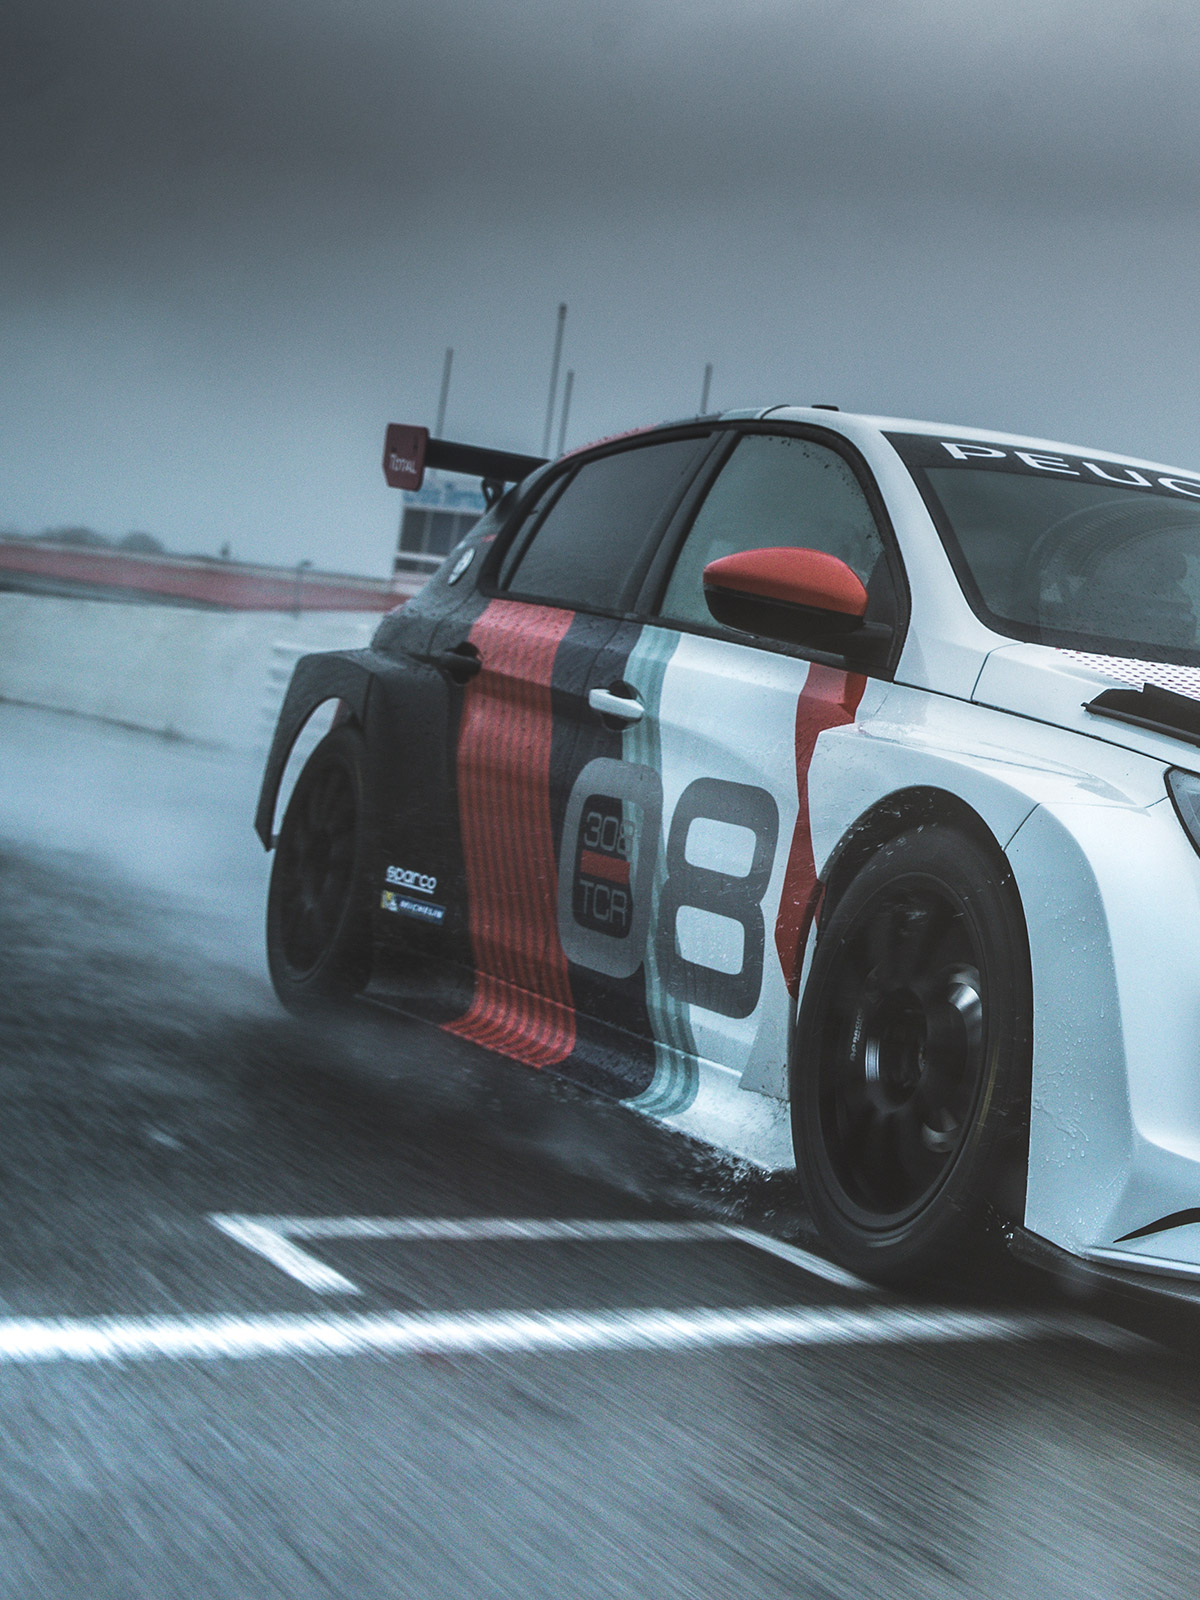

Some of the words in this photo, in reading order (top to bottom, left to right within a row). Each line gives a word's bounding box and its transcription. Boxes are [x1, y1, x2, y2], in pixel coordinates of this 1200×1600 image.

[390, 453, 417, 474] TOTAL
[583, 811, 636, 855] 308
[385, 865, 438, 892] sparco
[579, 878, 628, 927] TCR
